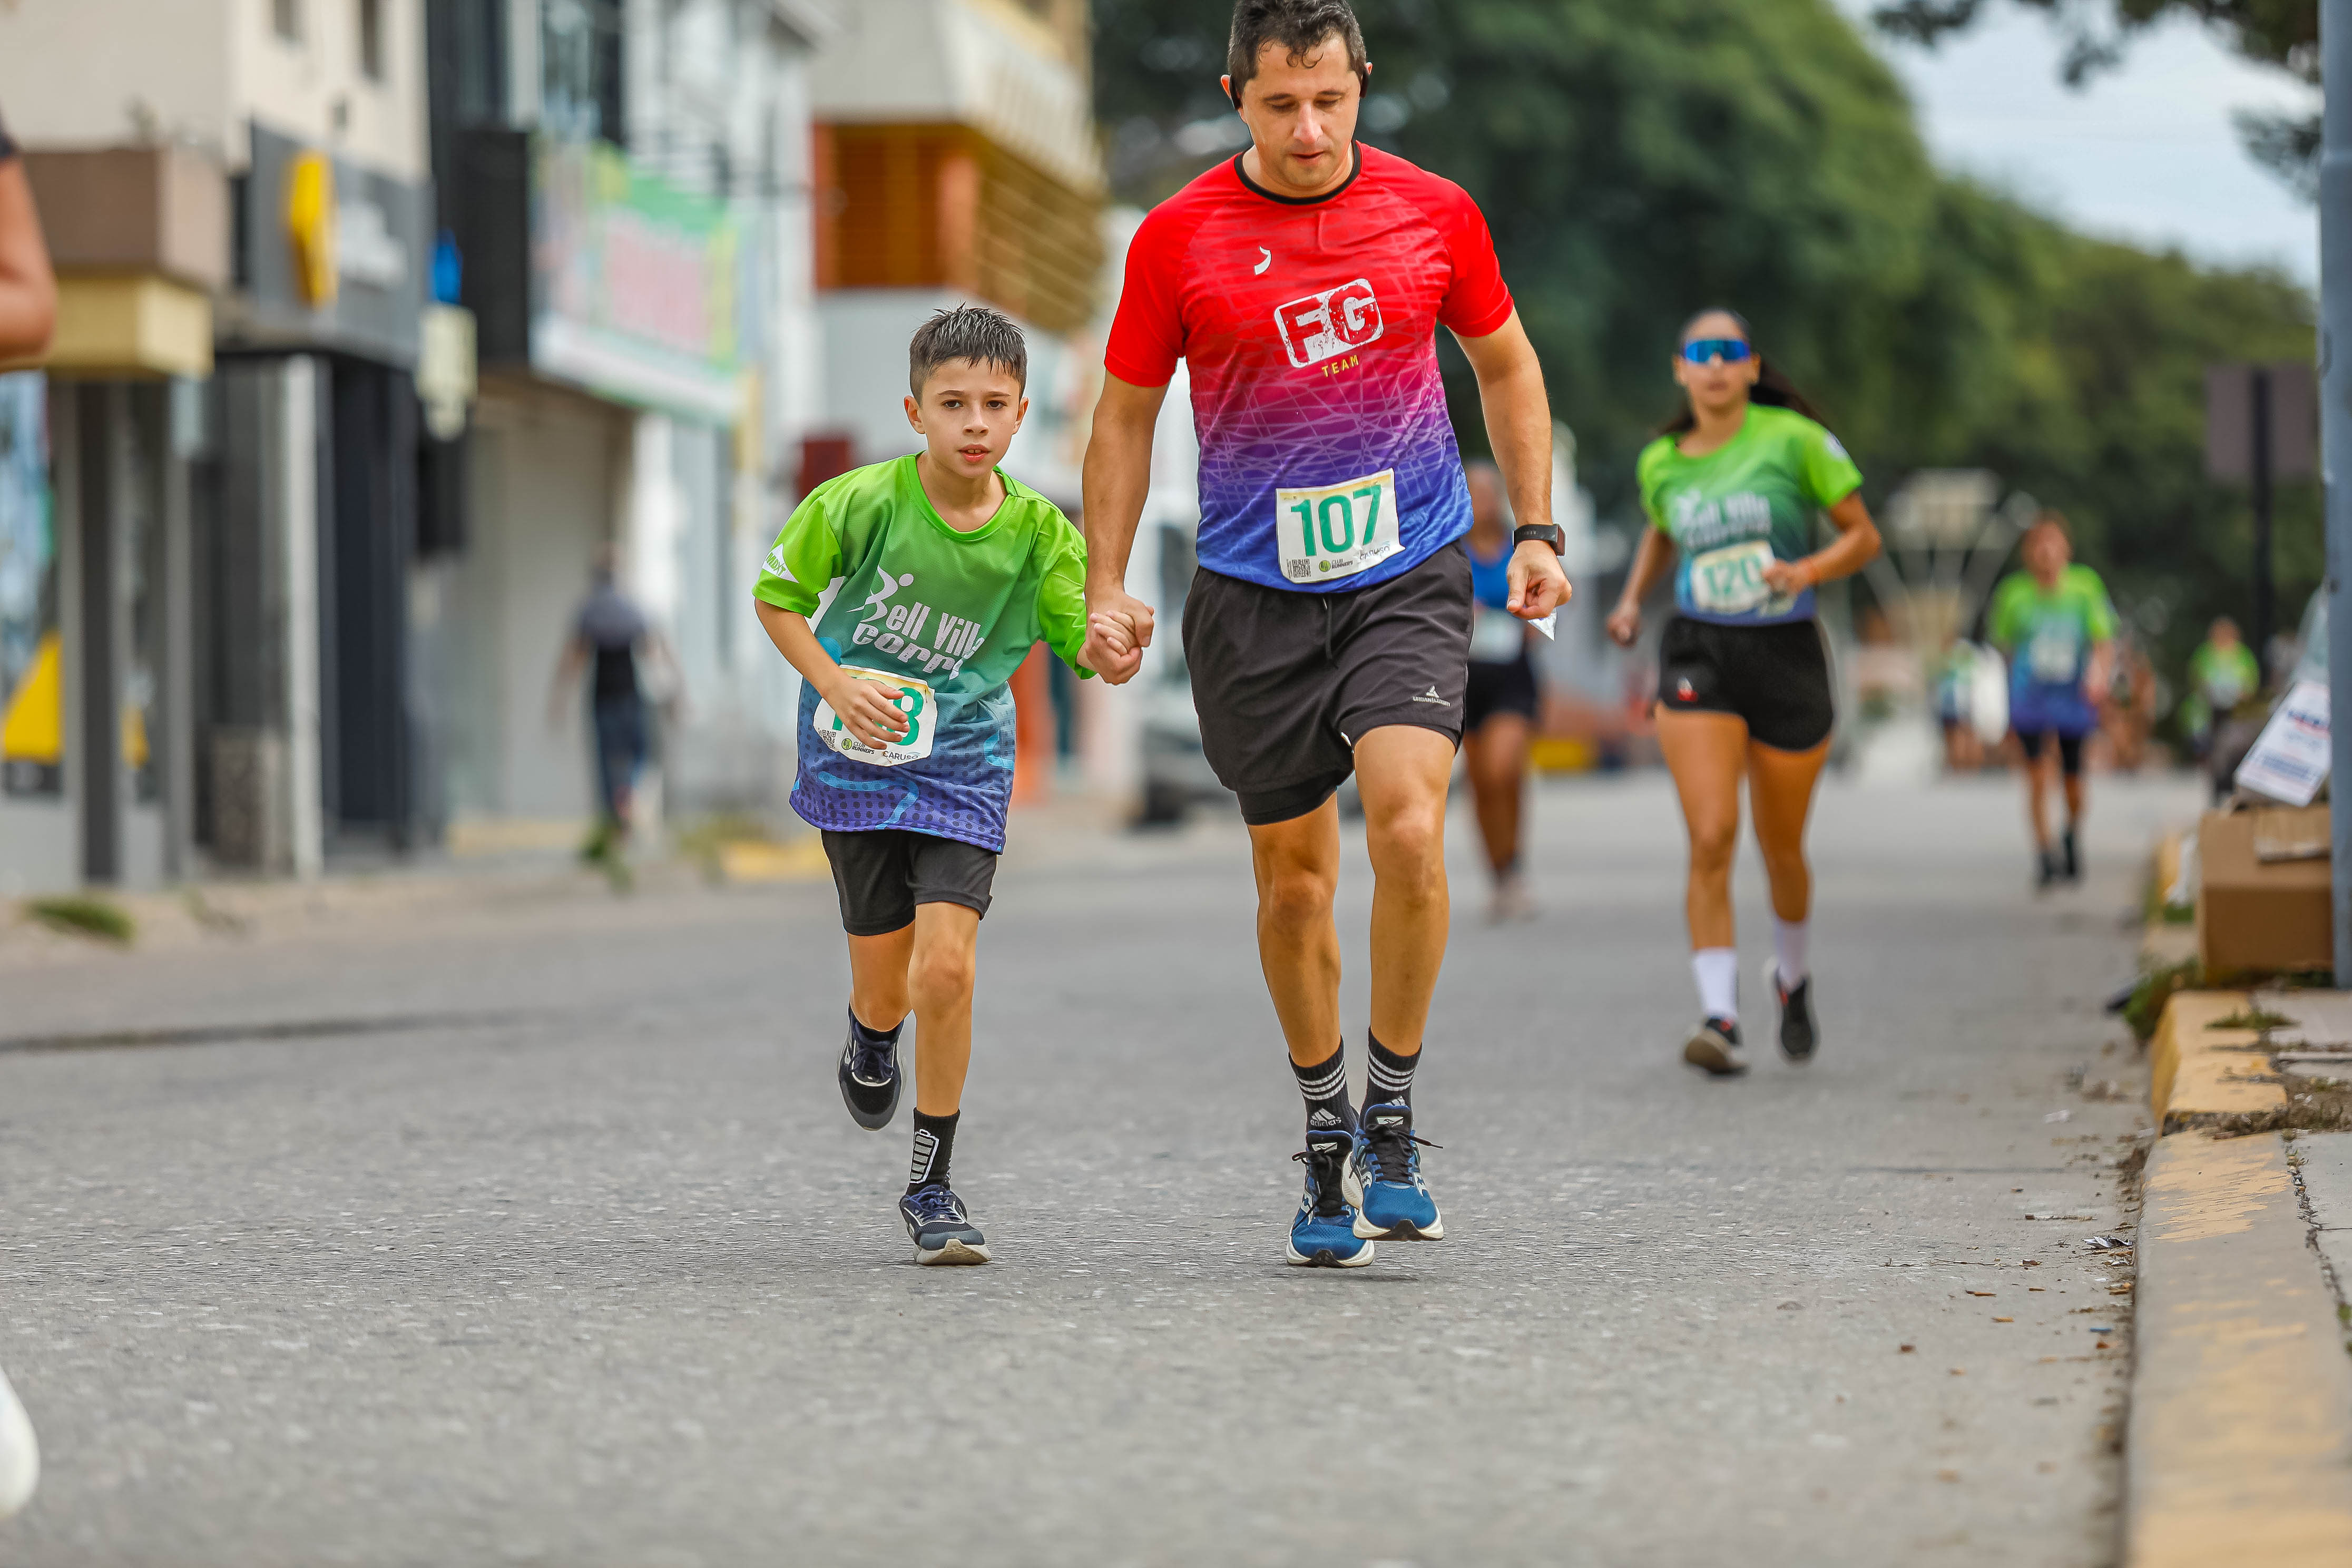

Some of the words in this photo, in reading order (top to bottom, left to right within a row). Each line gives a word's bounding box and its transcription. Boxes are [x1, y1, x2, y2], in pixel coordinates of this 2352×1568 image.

[1279, 285, 1380, 364] FG
[1321, 355, 1359, 377] TEAM
[1290, 484, 1382, 557] 107
[851, 746, 875, 754] RUNNER'S
[883, 750, 919, 760] CARUSO
